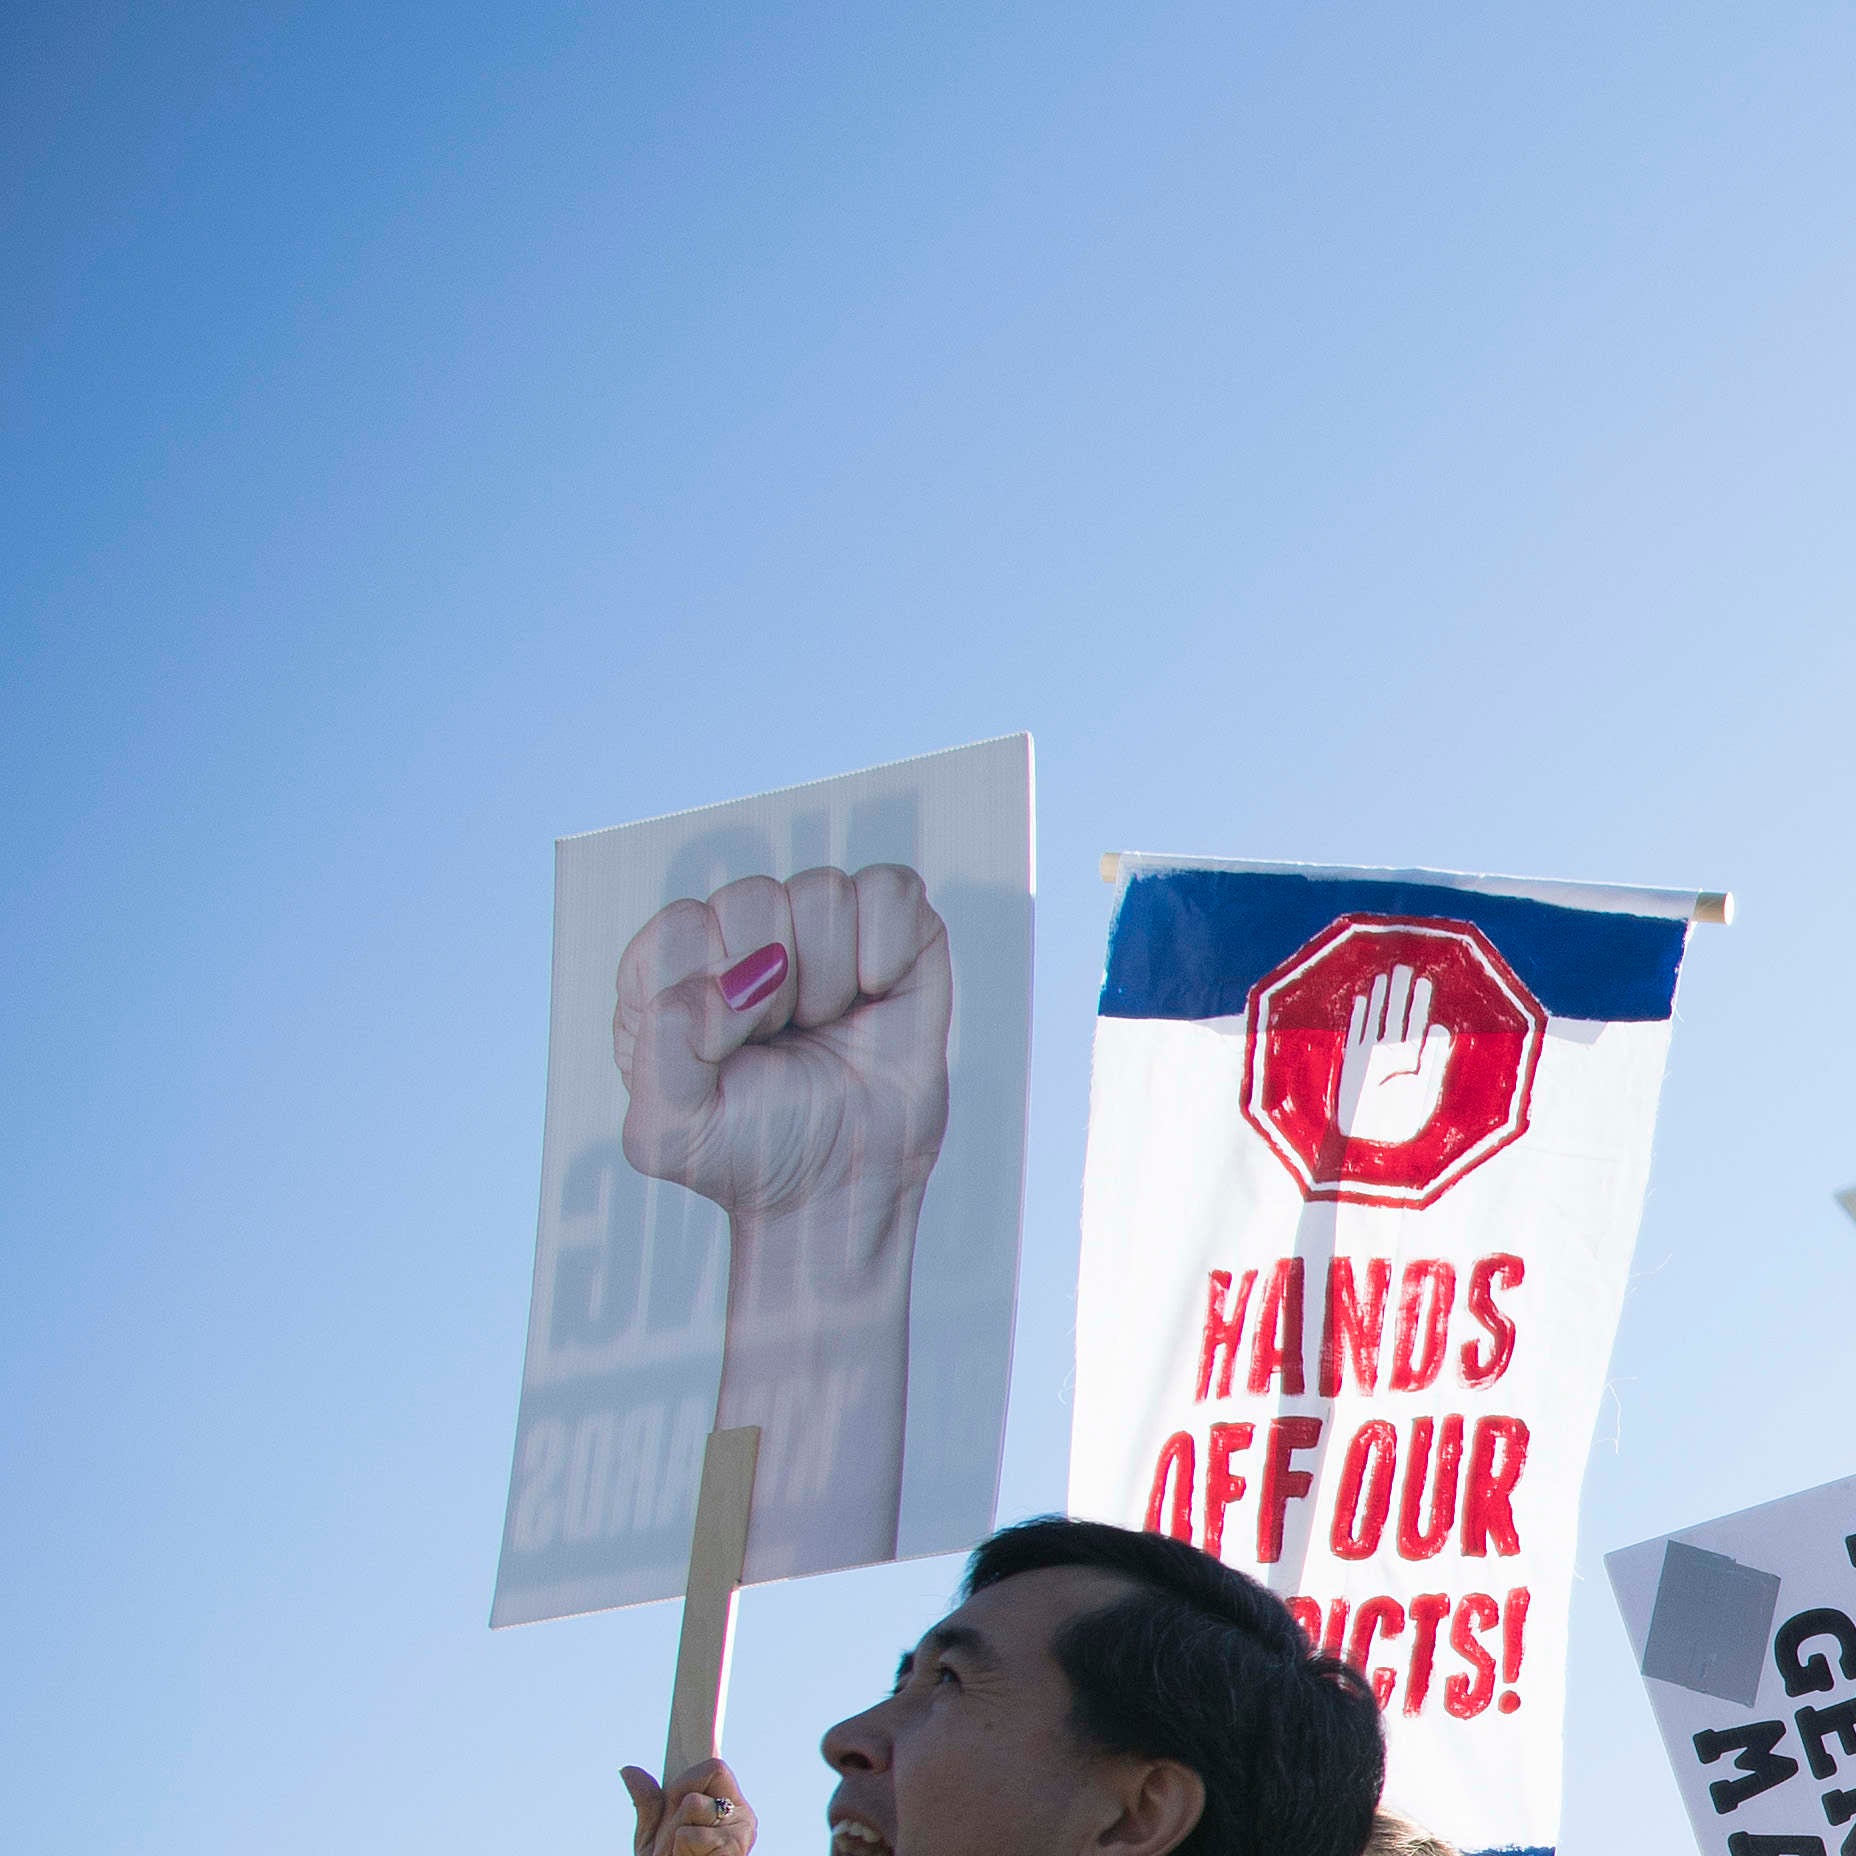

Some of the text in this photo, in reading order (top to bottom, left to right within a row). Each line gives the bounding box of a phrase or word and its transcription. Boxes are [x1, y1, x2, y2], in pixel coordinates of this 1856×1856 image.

[1195, 1251, 1524, 1402] HANDS
[1144, 1413, 1530, 1565] OFF OUR
